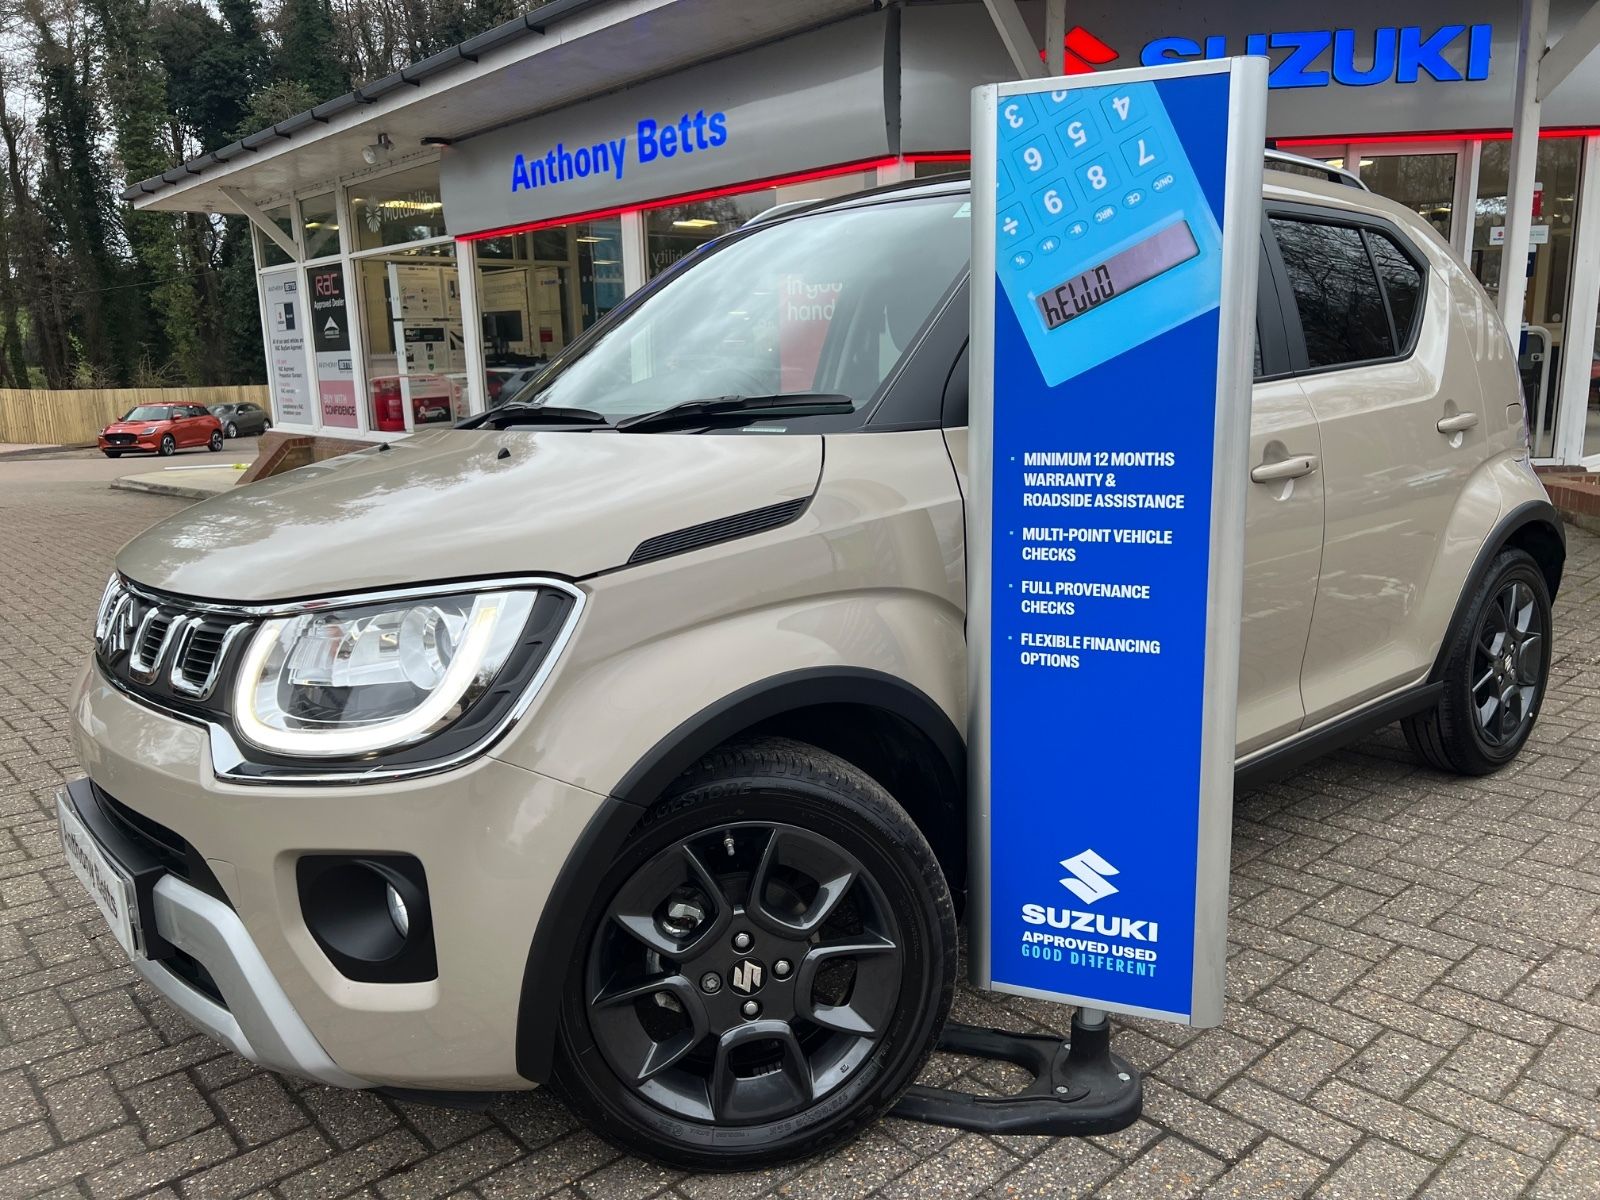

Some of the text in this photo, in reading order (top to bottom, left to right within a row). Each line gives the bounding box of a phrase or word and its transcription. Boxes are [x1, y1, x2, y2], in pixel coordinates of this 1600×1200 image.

[512, 109, 727, 192] Anthony Betts
[1025, 452, 1174, 466] MINIMUM 12 MONTHS
[1024, 473, 1115, 486] WARRANTY &
[1024, 493, 1184, 508] ROADSIDE ASSISTANCE
[1023, 528, 1172, 544] MULTI-POINT VEHICLE
[1023, 547, 1076, 561] CHECKS
[1022, 581, 1150, 598] FULL PROVENANCE
[1022, 600, 1074, 615] CHECKS
[1021, 633, 1160, 653] FLEXIBLE FINANCING
[1021, 652, 1079, 668] OPTIONS
[1022, 904, 1157, 943] SUZUKI
[1022, 931, 1156, 961] APPROVED USED
[1022, 944, 1062, 962] GOOD
